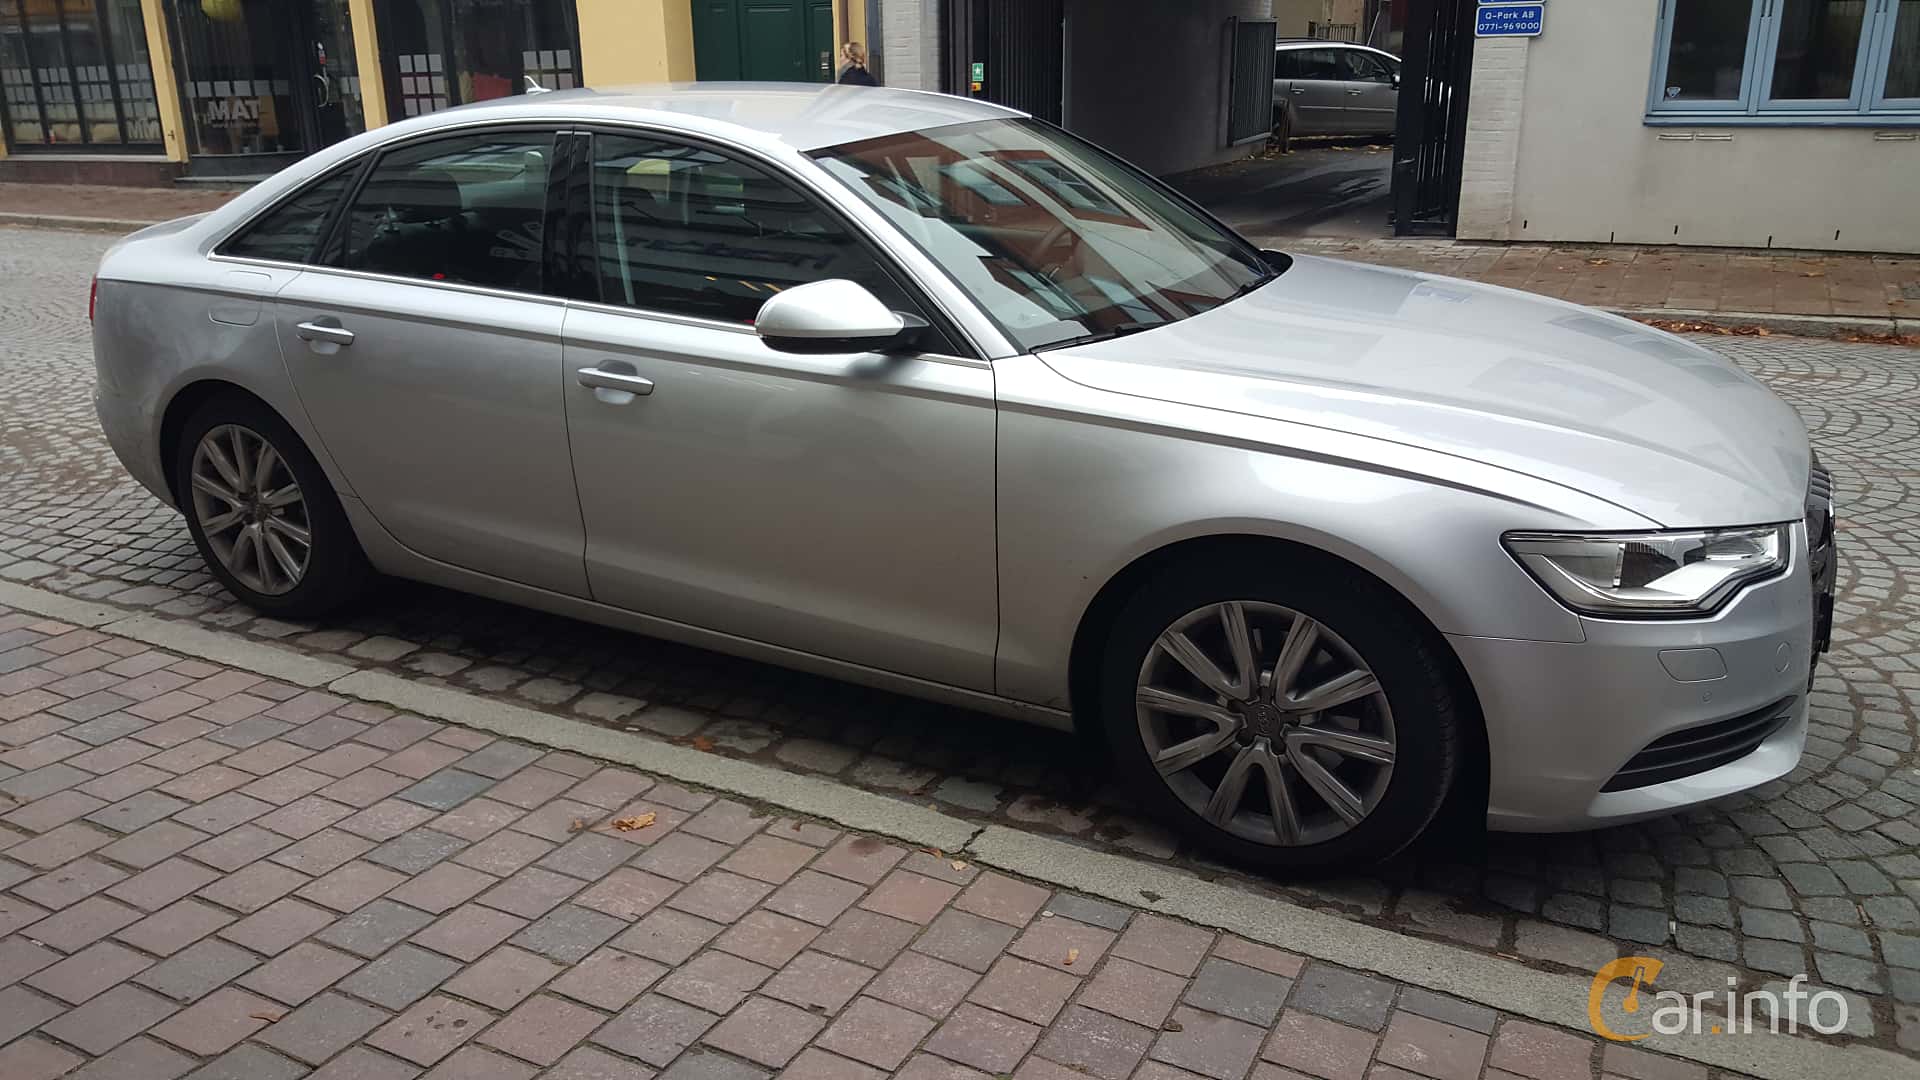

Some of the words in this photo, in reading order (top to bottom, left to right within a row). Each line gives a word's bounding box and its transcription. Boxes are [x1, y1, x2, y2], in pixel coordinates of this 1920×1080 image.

[1485, 11, 1519, 20] Q-Park
[1522, 11, 1535, 19] AB
[207, 99, 262, 121] MAT
